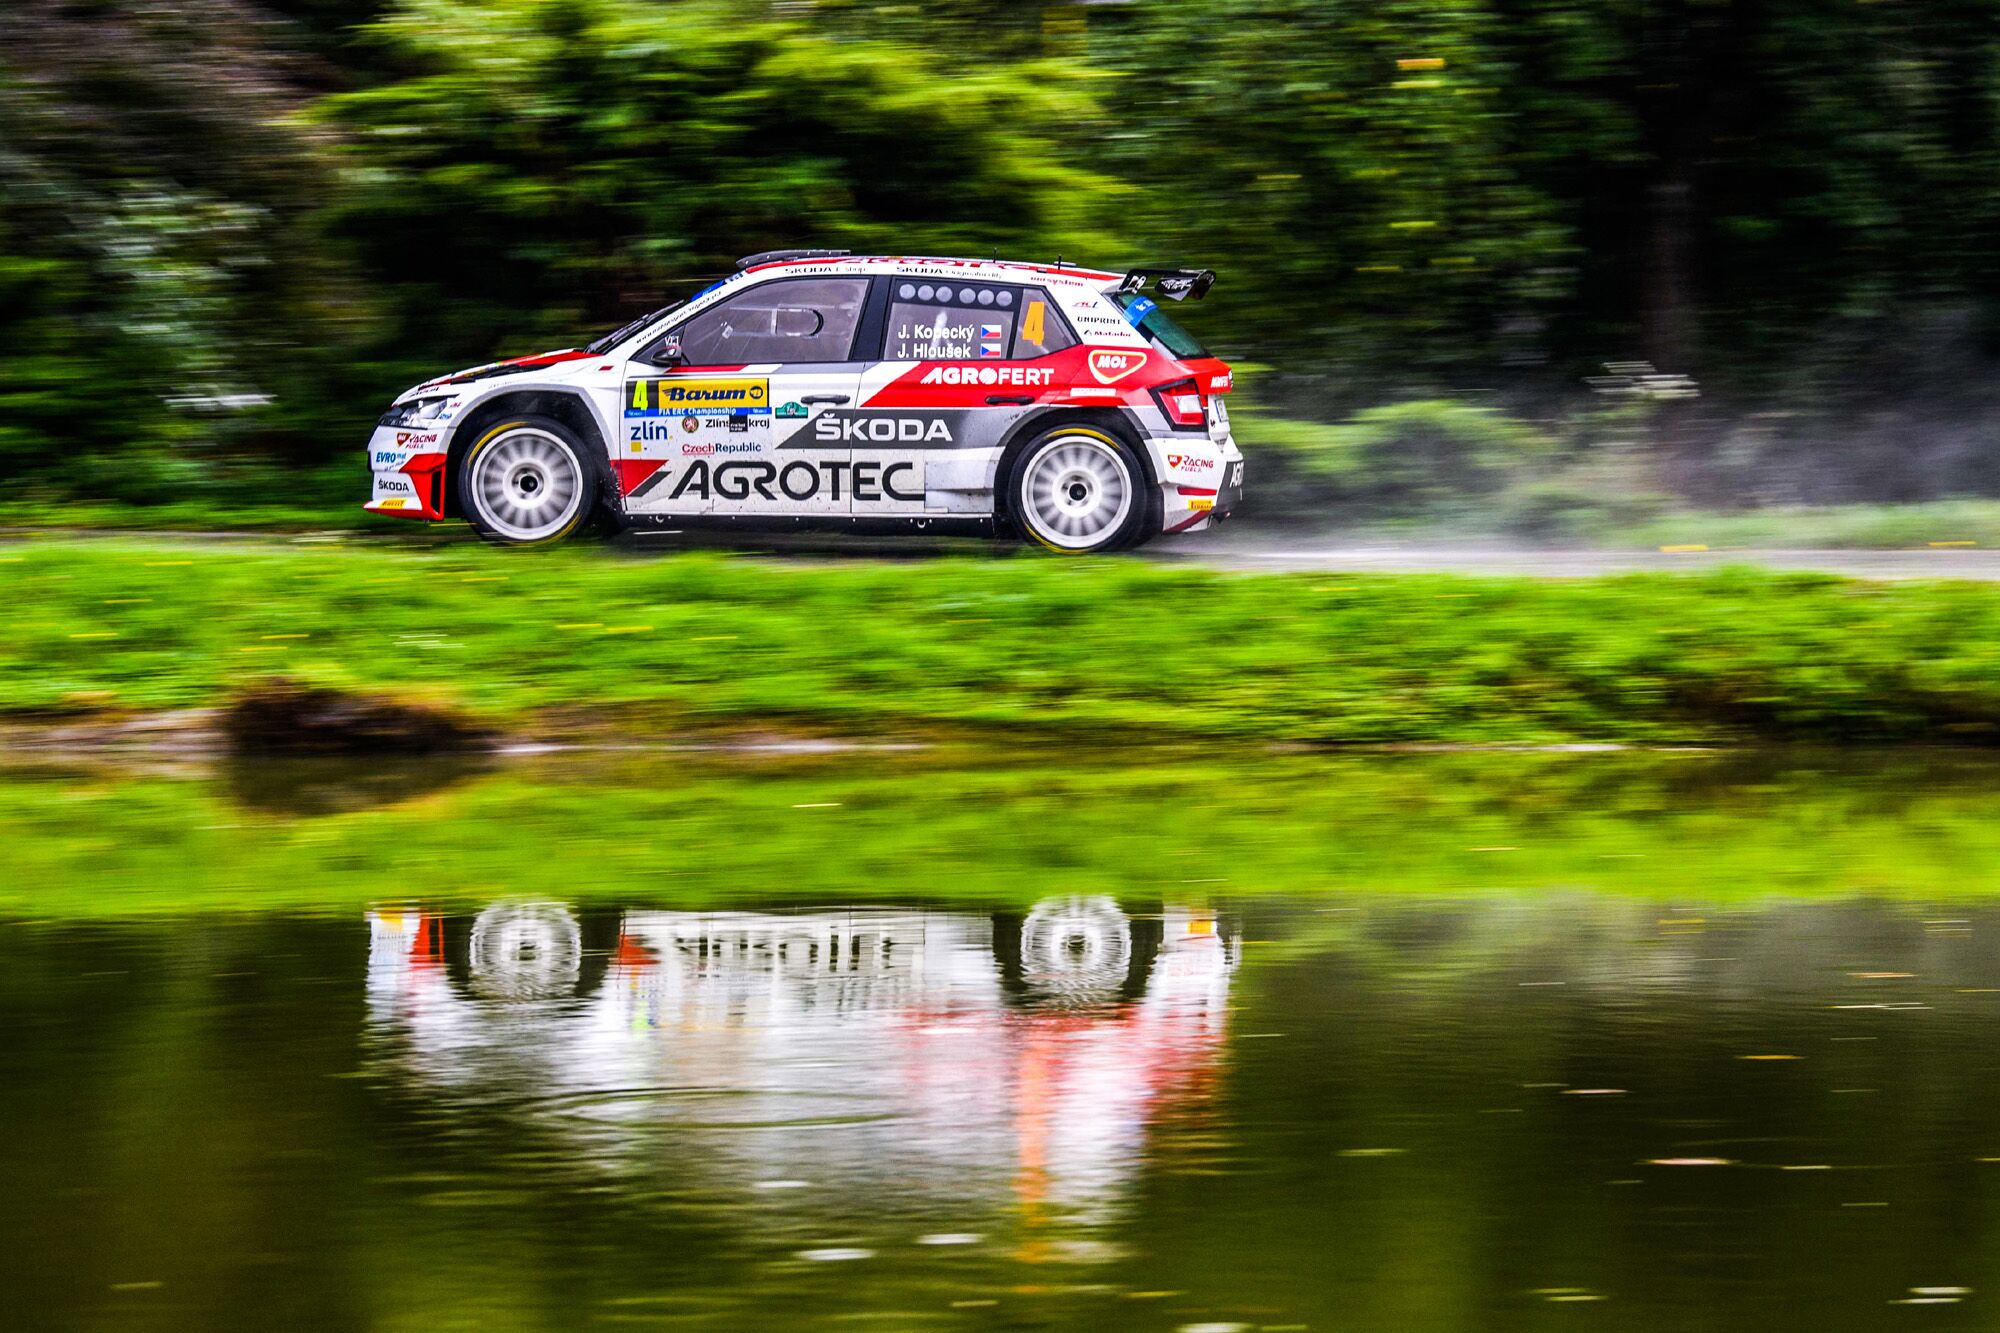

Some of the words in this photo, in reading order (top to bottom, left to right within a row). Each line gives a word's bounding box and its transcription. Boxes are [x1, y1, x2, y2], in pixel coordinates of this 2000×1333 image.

[1022, 301, 1045, 346] 4
[898, 325, 910, 339] J.
[914, 324, 975, 342] Kopecký
[898, 344, 909, 358] J.
[913, 343, 972, 358] Hloušek
[1097, 355, 1127, 369] MOL
[920, 367, 1054, 385] AGROFERT
[632, 380, 649, 410] 4
[670, 387, 746, 401] Barum
[688, 407, 736, 416] Championship
[749, 418, 769, 429] kraj
[816, 413, 953, 441] ŠKODA
[1182, 455, 1214, 468] RACING
[378, 478, 410, 492] ŠKODA
[668, 459, 926, 501] AGROTEC
